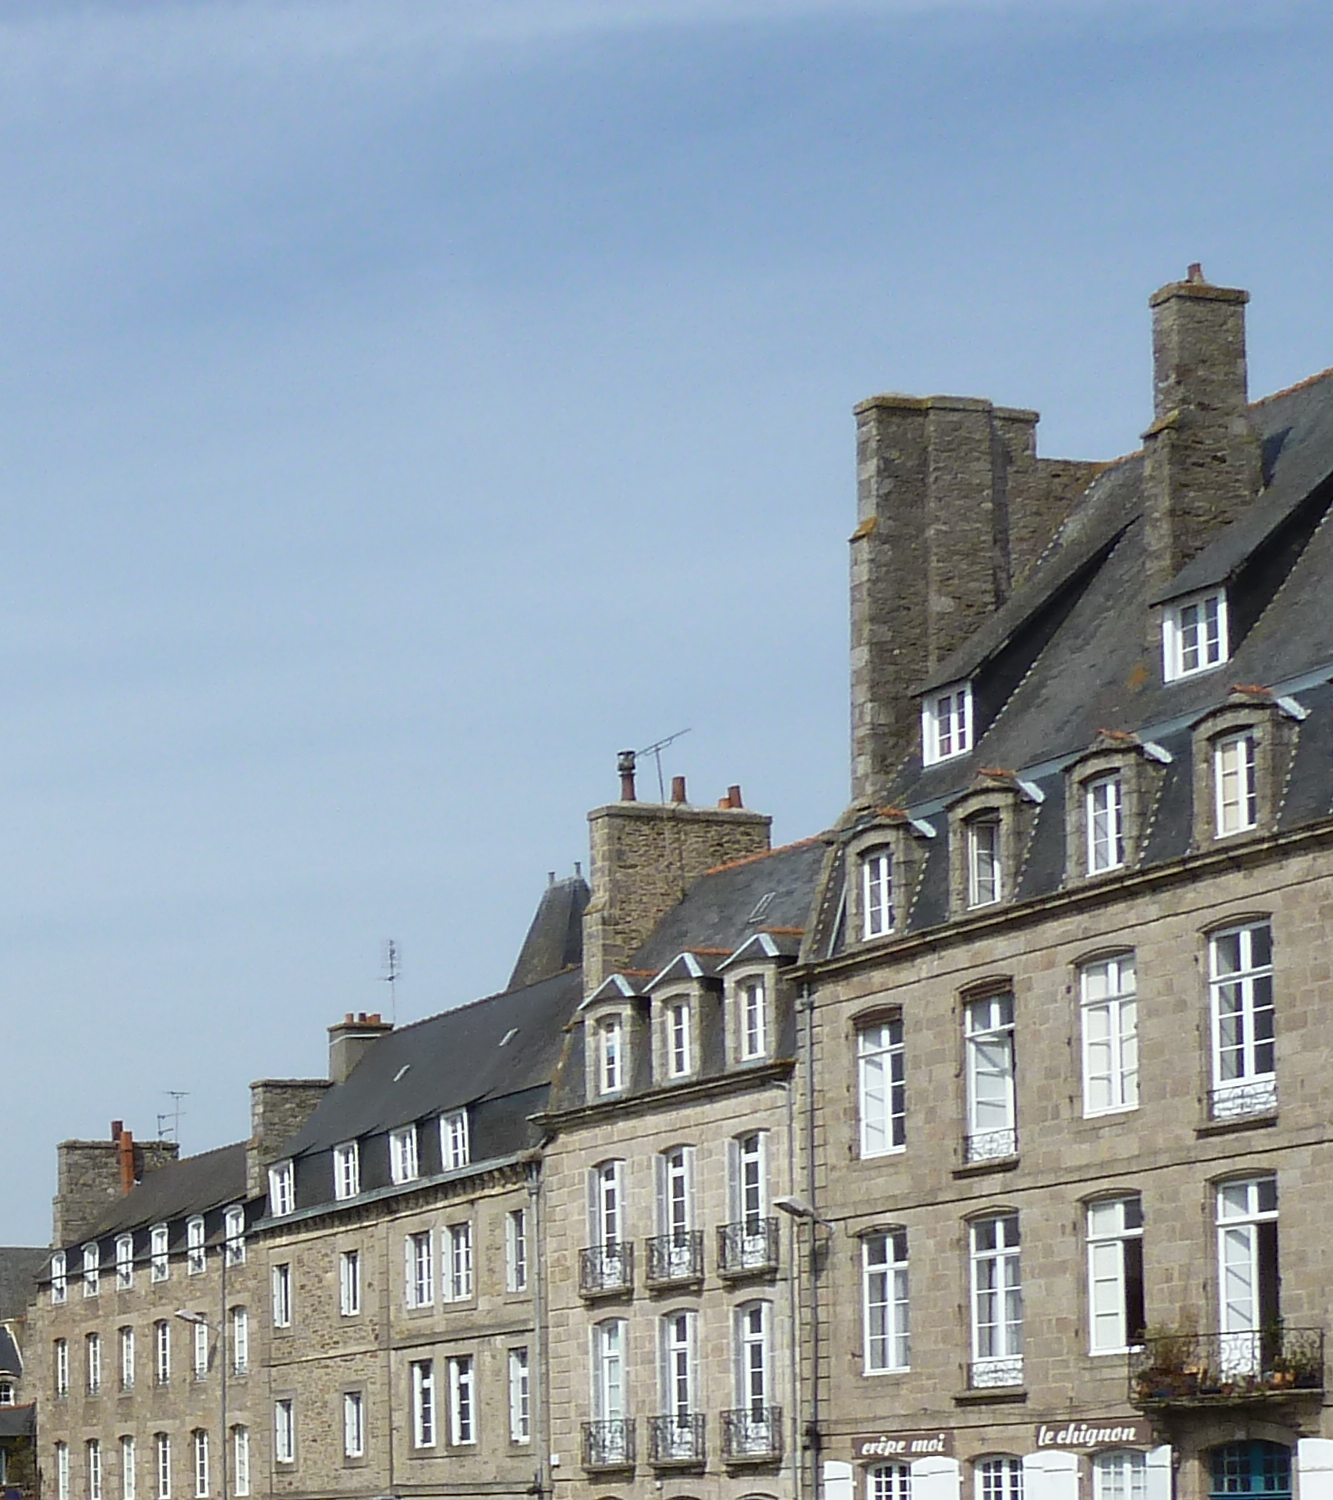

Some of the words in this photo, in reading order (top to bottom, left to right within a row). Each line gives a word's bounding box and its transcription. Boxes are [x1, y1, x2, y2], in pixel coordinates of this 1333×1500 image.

[861, 1436, 905, 1455] crêpe
[912, 1434, 945, 1453] moi
[1038, 1425, 1054, 1446] le
[1057, 1423, 1137, 1447] chignon
